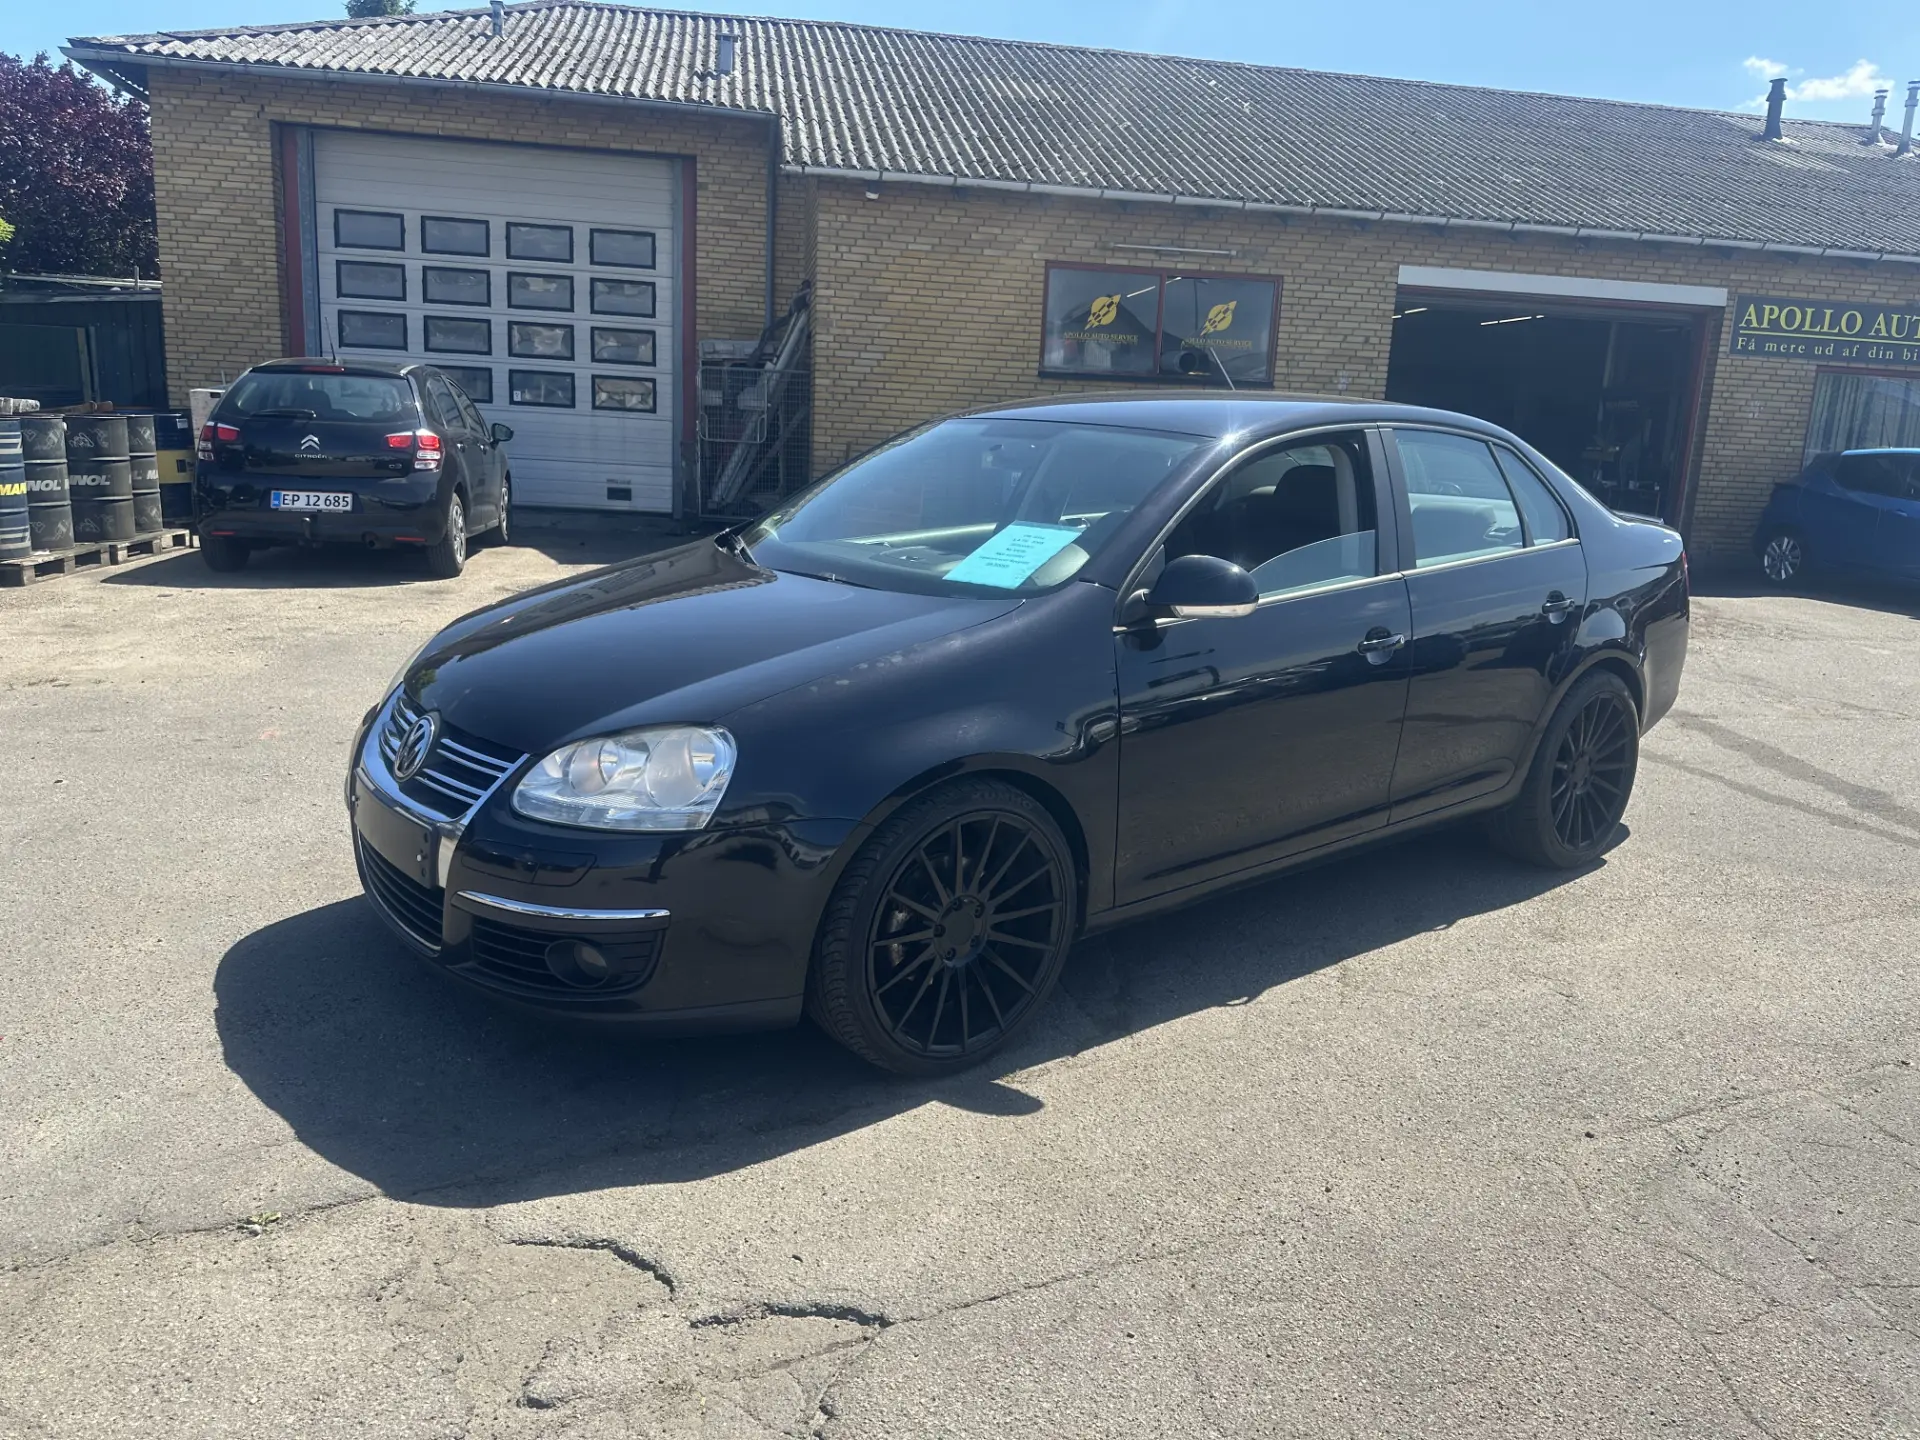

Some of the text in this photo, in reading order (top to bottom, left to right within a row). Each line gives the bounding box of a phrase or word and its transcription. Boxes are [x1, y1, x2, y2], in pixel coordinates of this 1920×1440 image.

[1738, 303, 1863, 335] APOLLO
[1111, 334, 1139, 342] SERVICE
[1736, 337, 1756, 351] Få
[1765, 342, 1806, 354] mere
[1814, 343, 1834, 356] ud
[1842, 344, 1860, 357] af
[1868, 346, 1895, 360] din
[282, 493, 350, 508] EP 12 685
